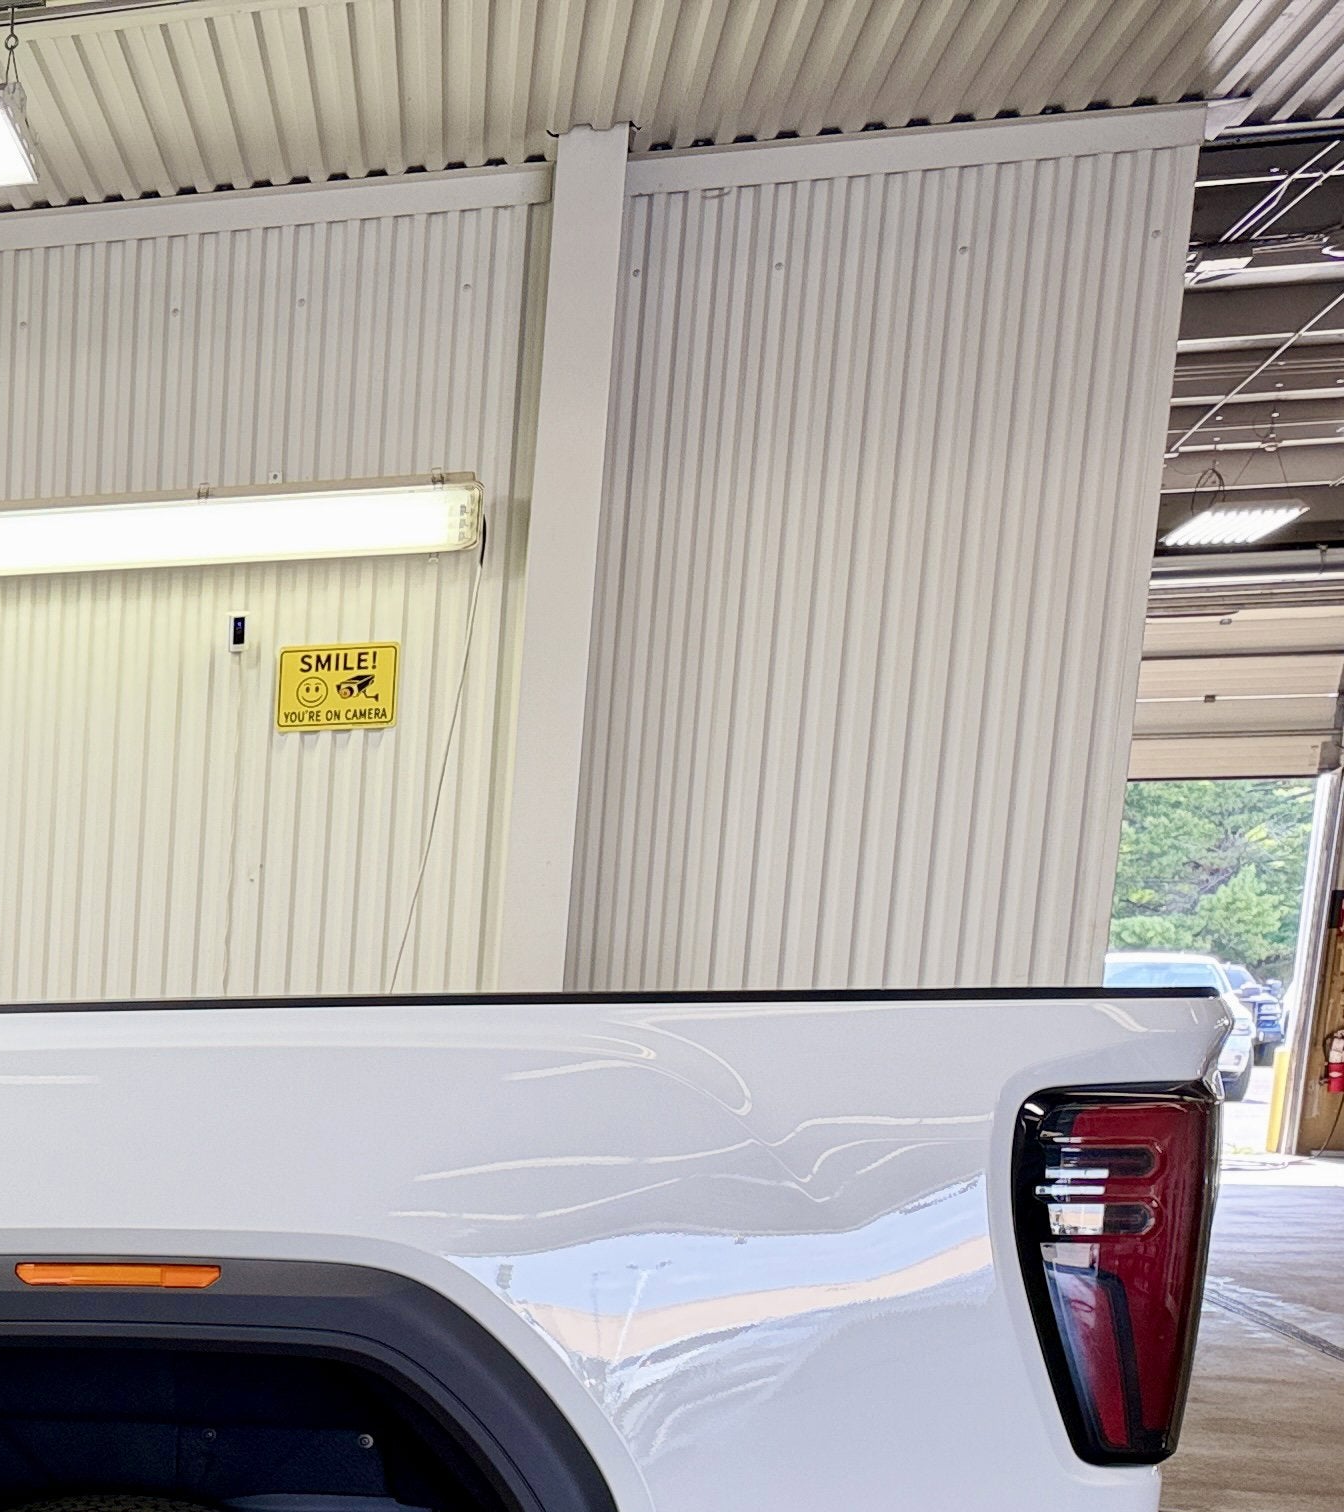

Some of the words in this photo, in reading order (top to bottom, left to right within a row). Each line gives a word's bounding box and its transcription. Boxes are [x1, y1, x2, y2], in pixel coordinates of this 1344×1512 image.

[299, 651, 378, 673] SMILE!
[283, 709, 321, 724] YOU'RE
[325, 708, 341, 721] ON
[345, 707, 387, 721] CAMERA
